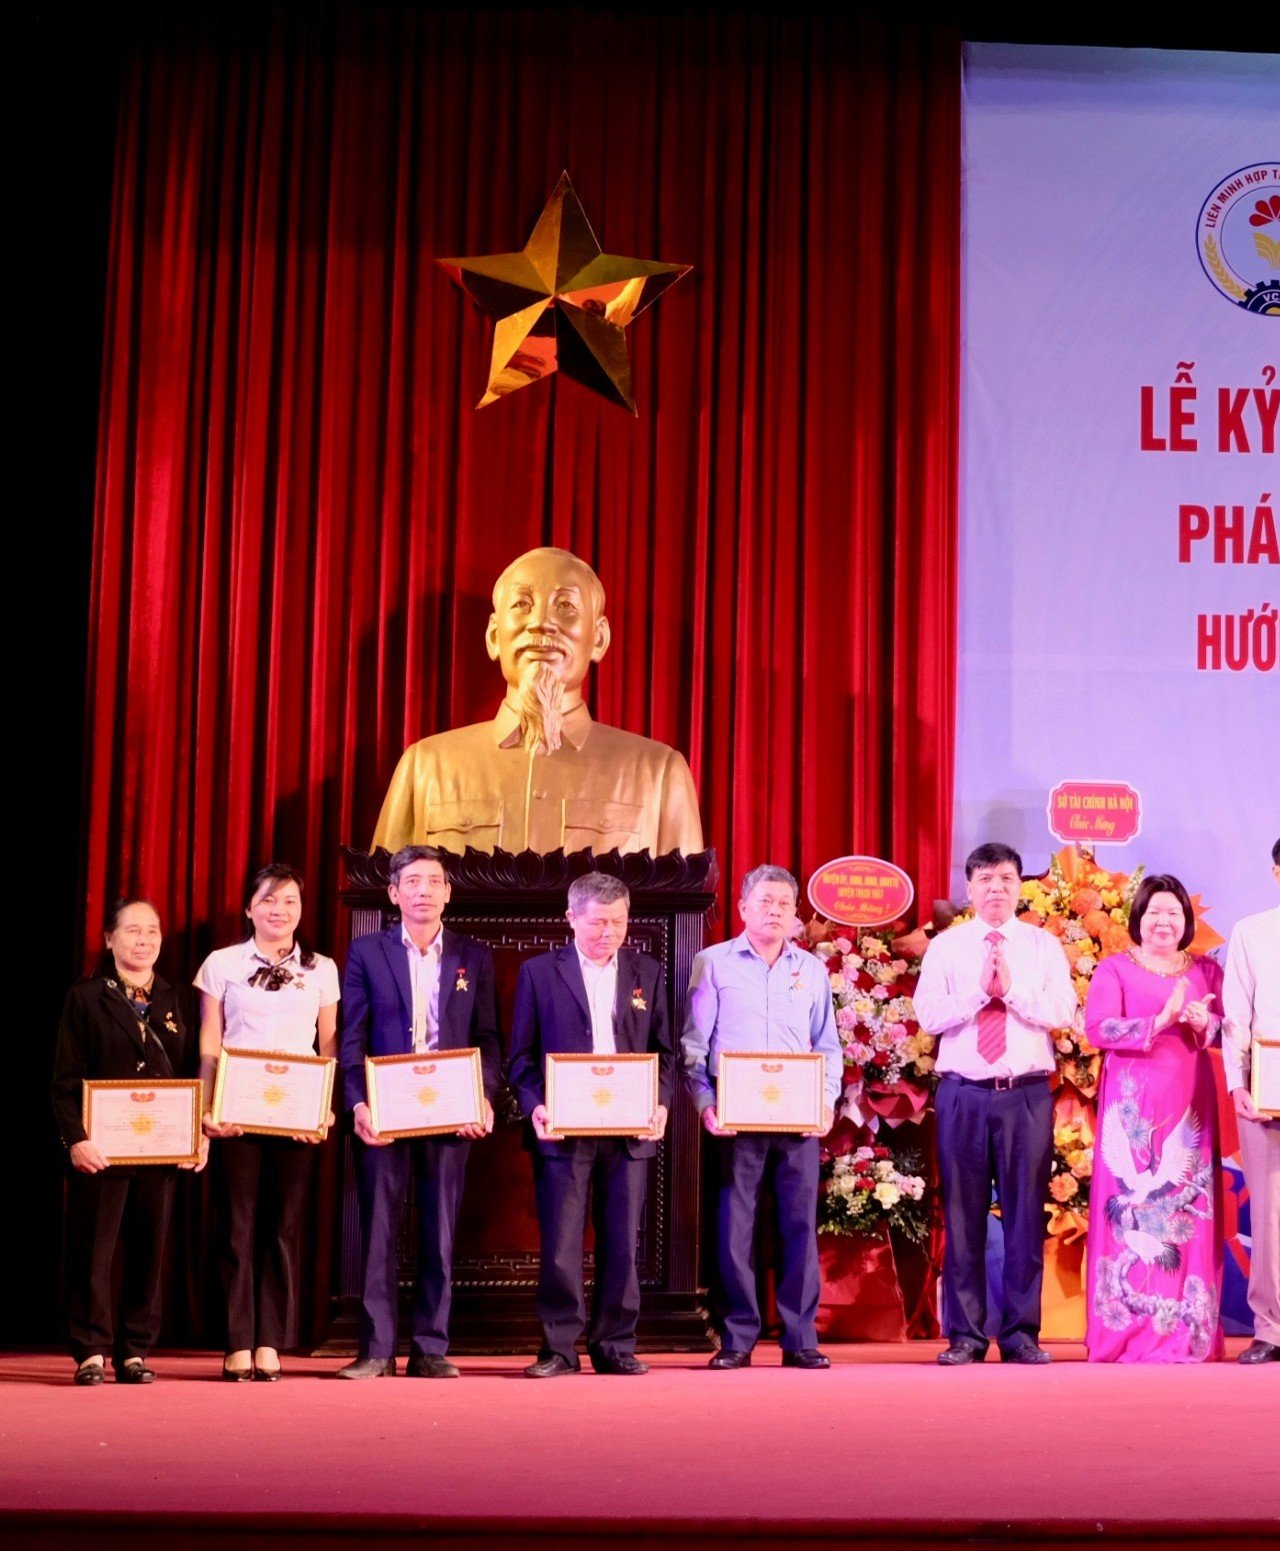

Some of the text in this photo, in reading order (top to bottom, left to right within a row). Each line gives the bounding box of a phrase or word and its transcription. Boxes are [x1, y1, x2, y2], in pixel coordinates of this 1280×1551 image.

[1205, 204, 1222, 229] LIÊN
[1217, 178, 1244, 204] MINH
[1245, 169, 1267, 185] HỢP
[1141, 362, 1197, 451] LỄ
